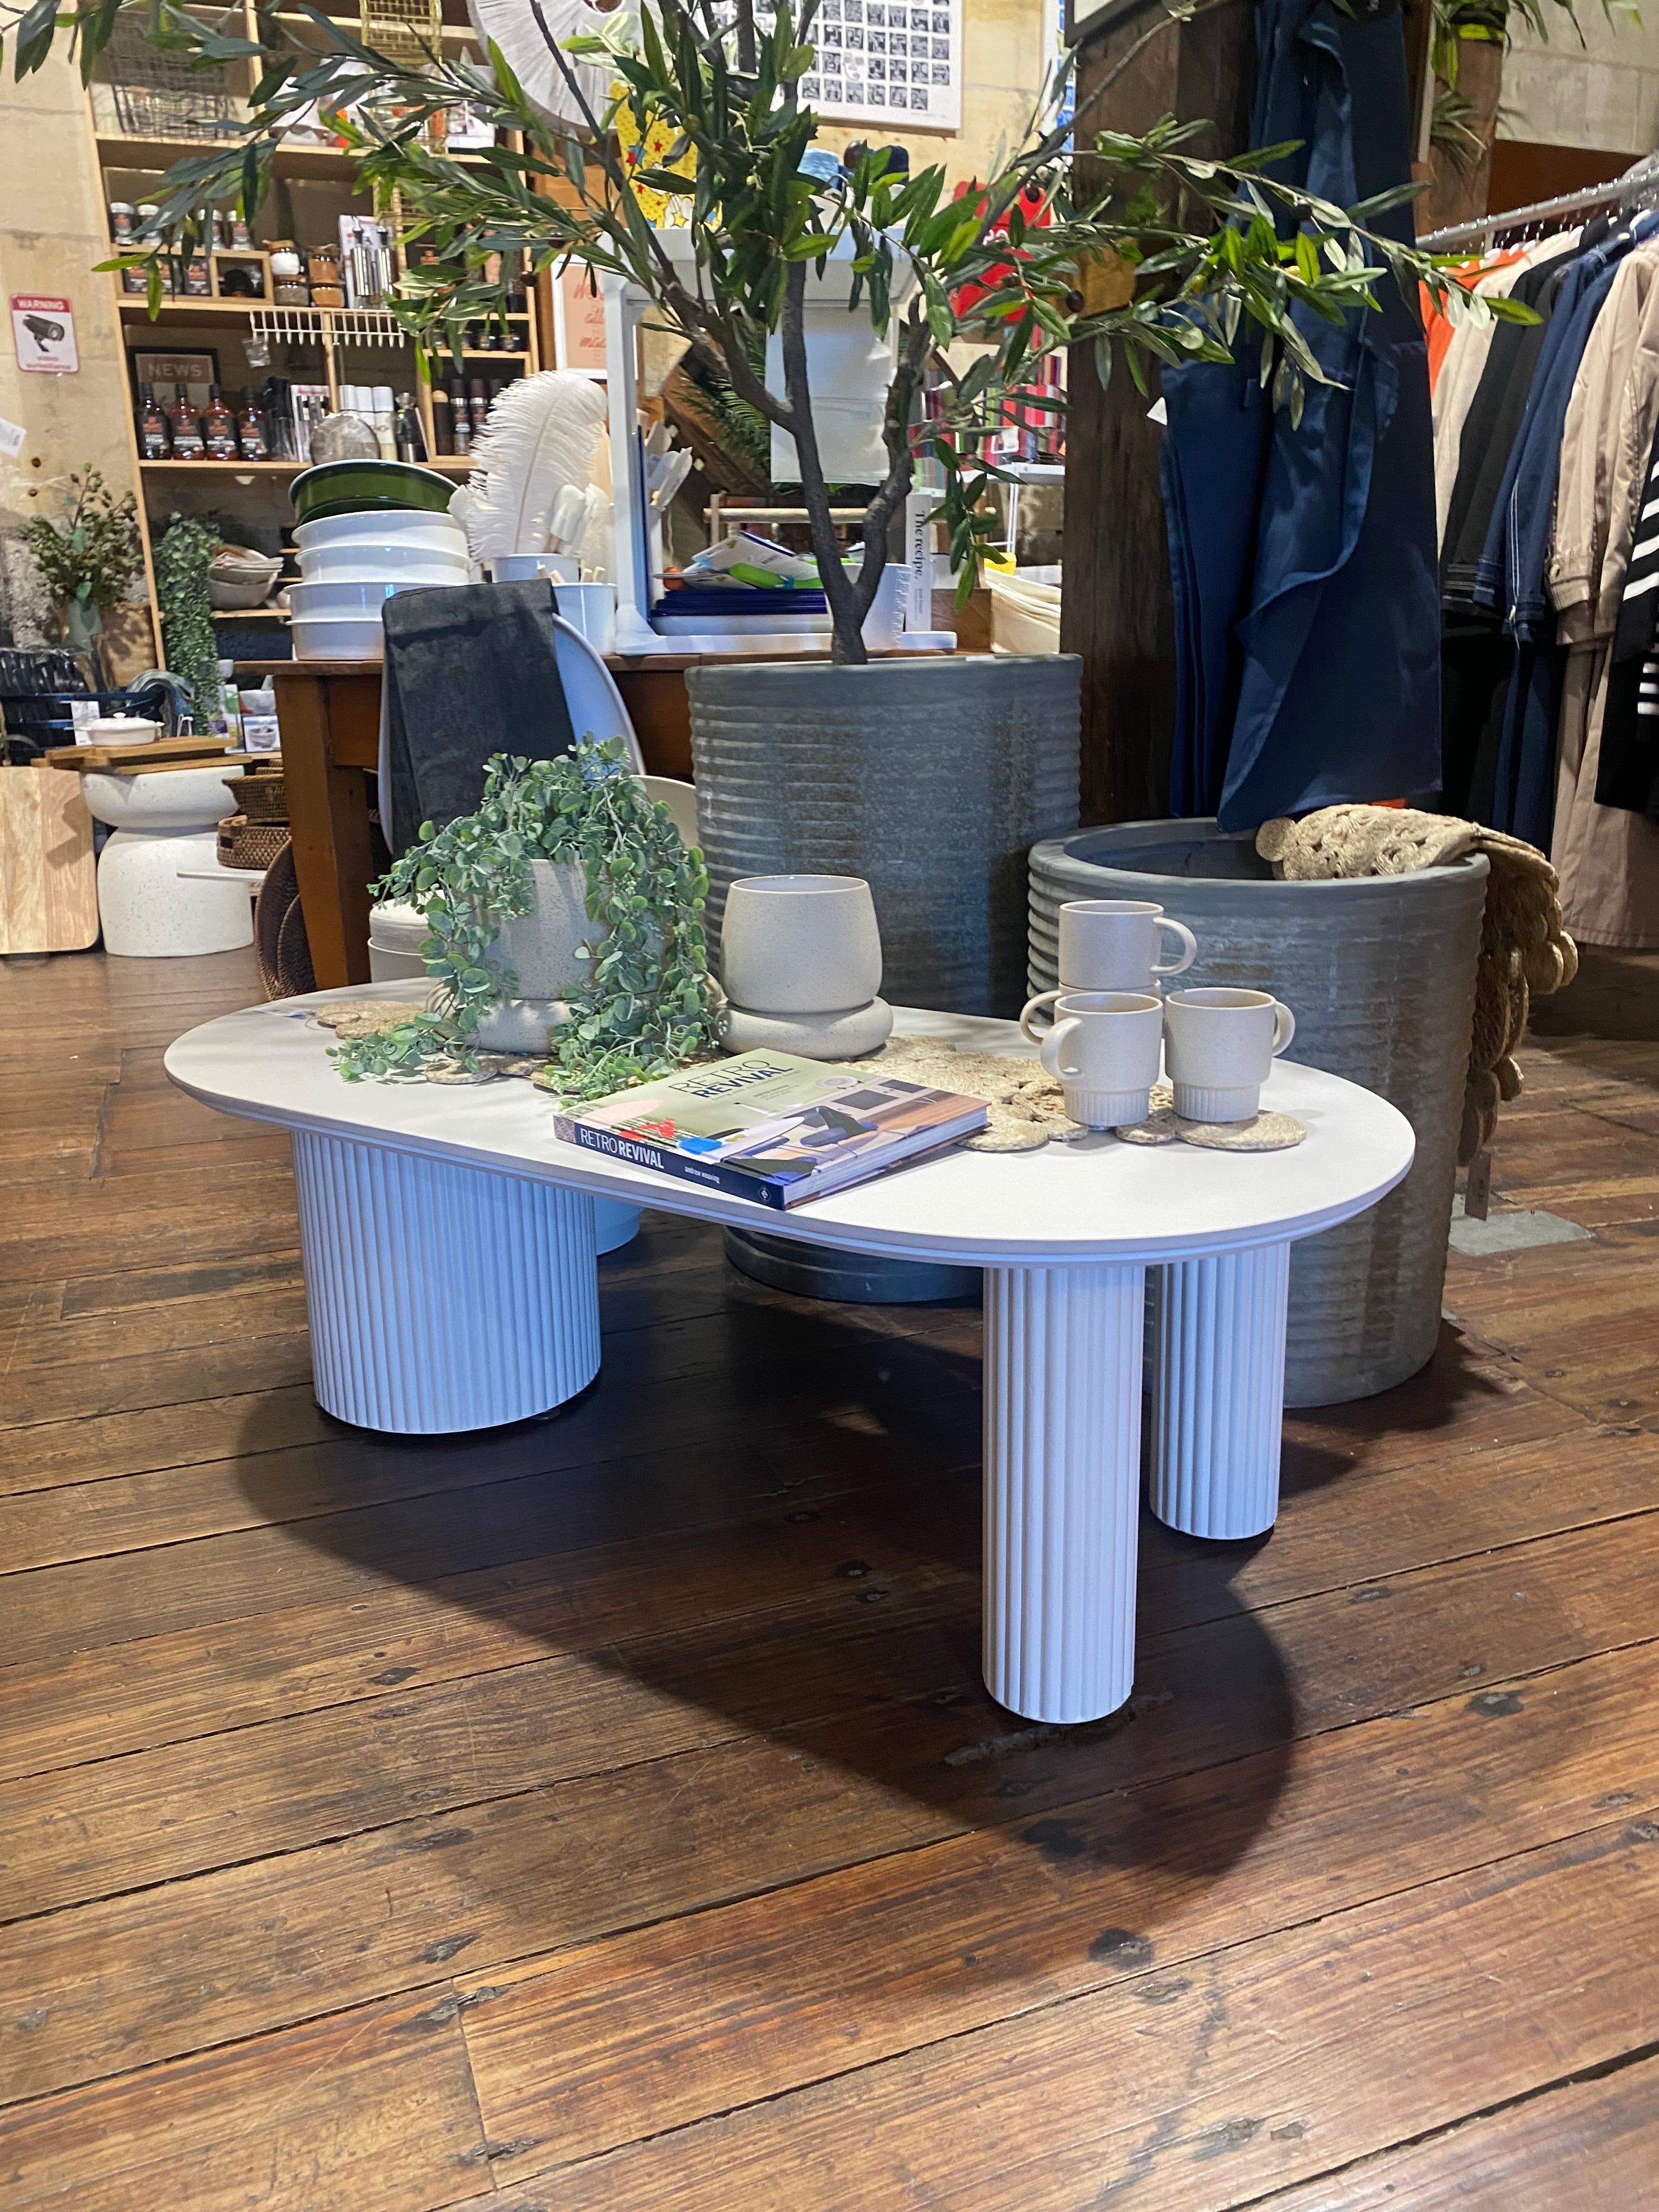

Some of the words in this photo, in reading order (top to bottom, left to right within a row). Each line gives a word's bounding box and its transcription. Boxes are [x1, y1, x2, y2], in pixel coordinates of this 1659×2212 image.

[17, 300, 64, 311] WARNING
[148, 363, 202, 377] NEWS
[915, 511, 926, 535] The
[668, 1060, 770, 1092] RETRO
[691, 1066, 794, 1098] REVIVAL
[580, 1128, 618, 1153] RETRO
[618, 1140, 664, 1169] REVIVAL
